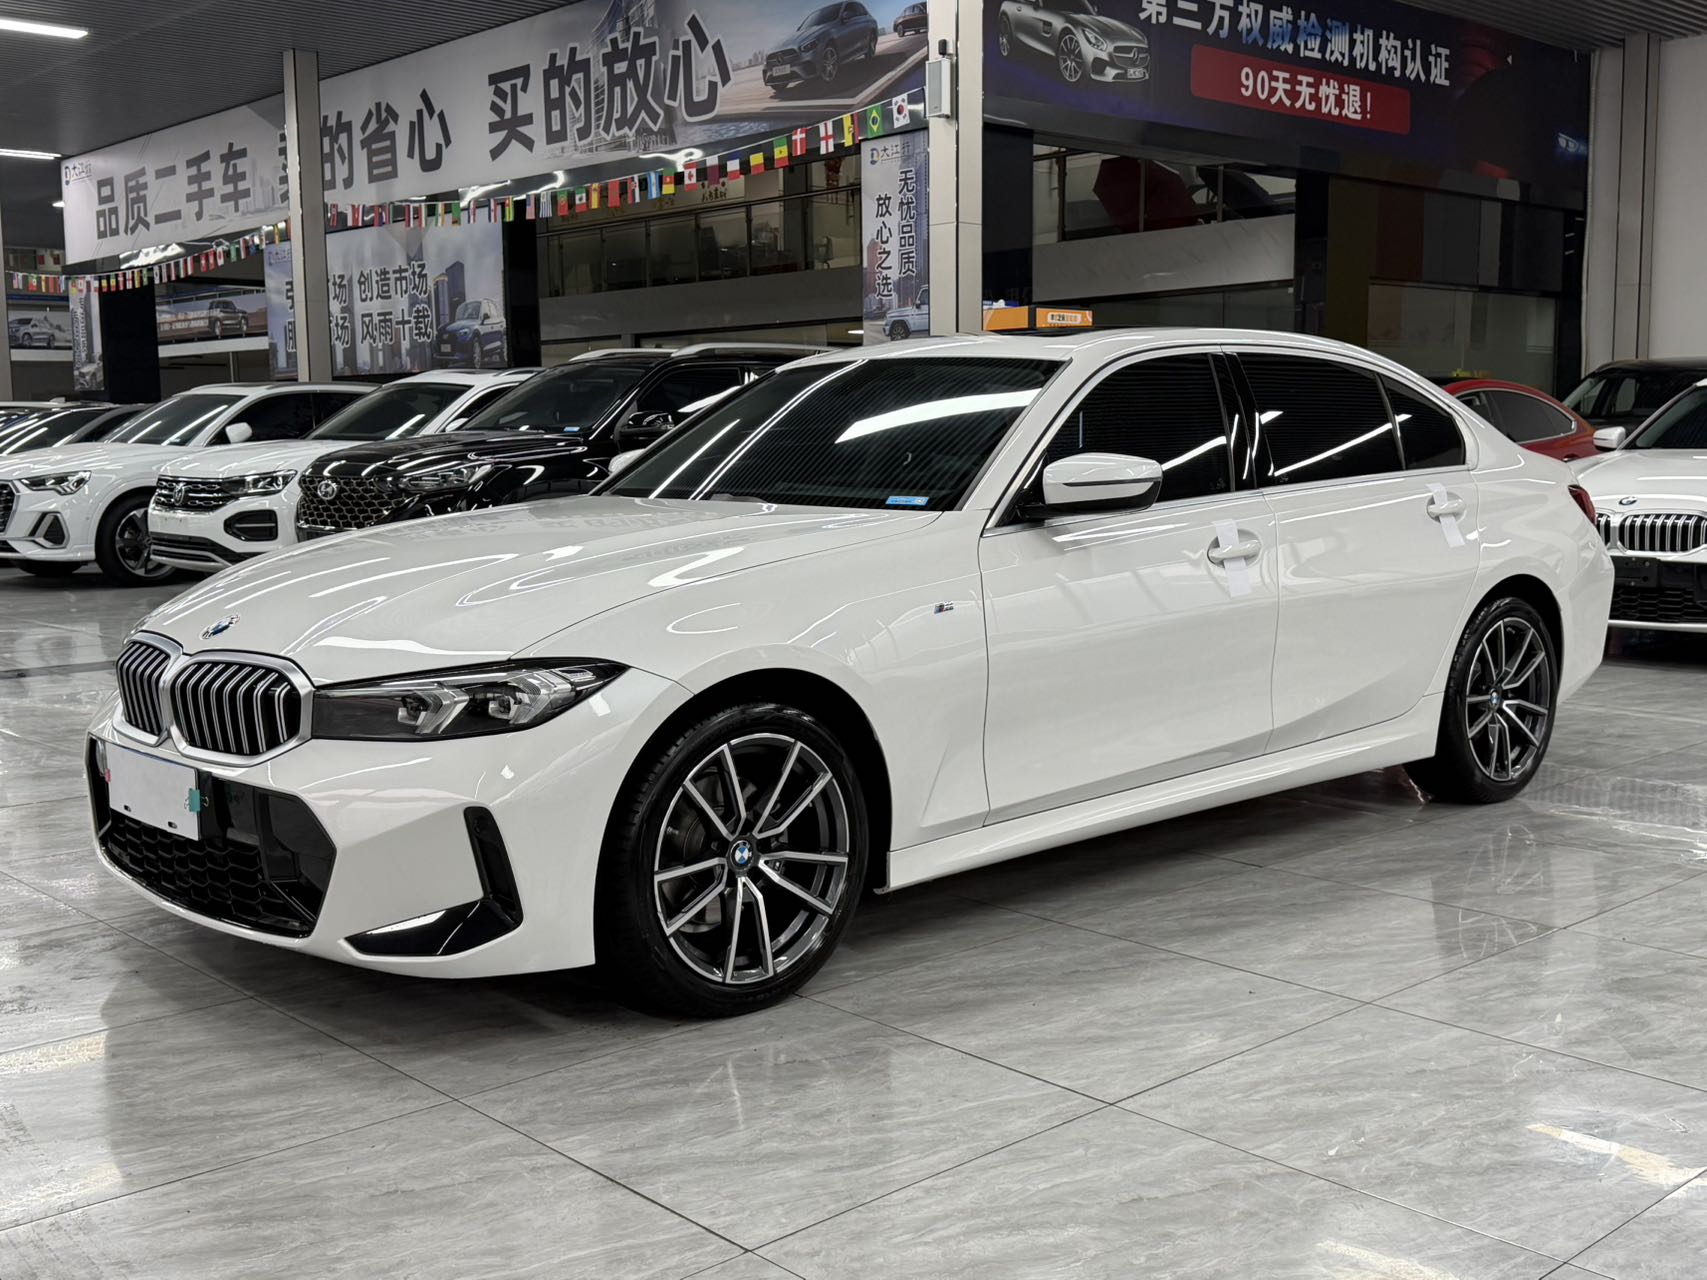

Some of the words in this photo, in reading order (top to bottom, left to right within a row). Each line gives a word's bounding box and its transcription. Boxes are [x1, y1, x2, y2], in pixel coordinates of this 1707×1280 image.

[96, 142, 251, 240] 品质二手车
[488, 13, 732, 162] 买的放心
[1240, 66, 1372, 120] 90天无忧退!
[876, 193, 893, 298] 放心之选
[898, 169, 916, 276] 无忧品质
[357, 261, 429, 302] 创造市场
[360, 304, 433, 345] 风雨十载
